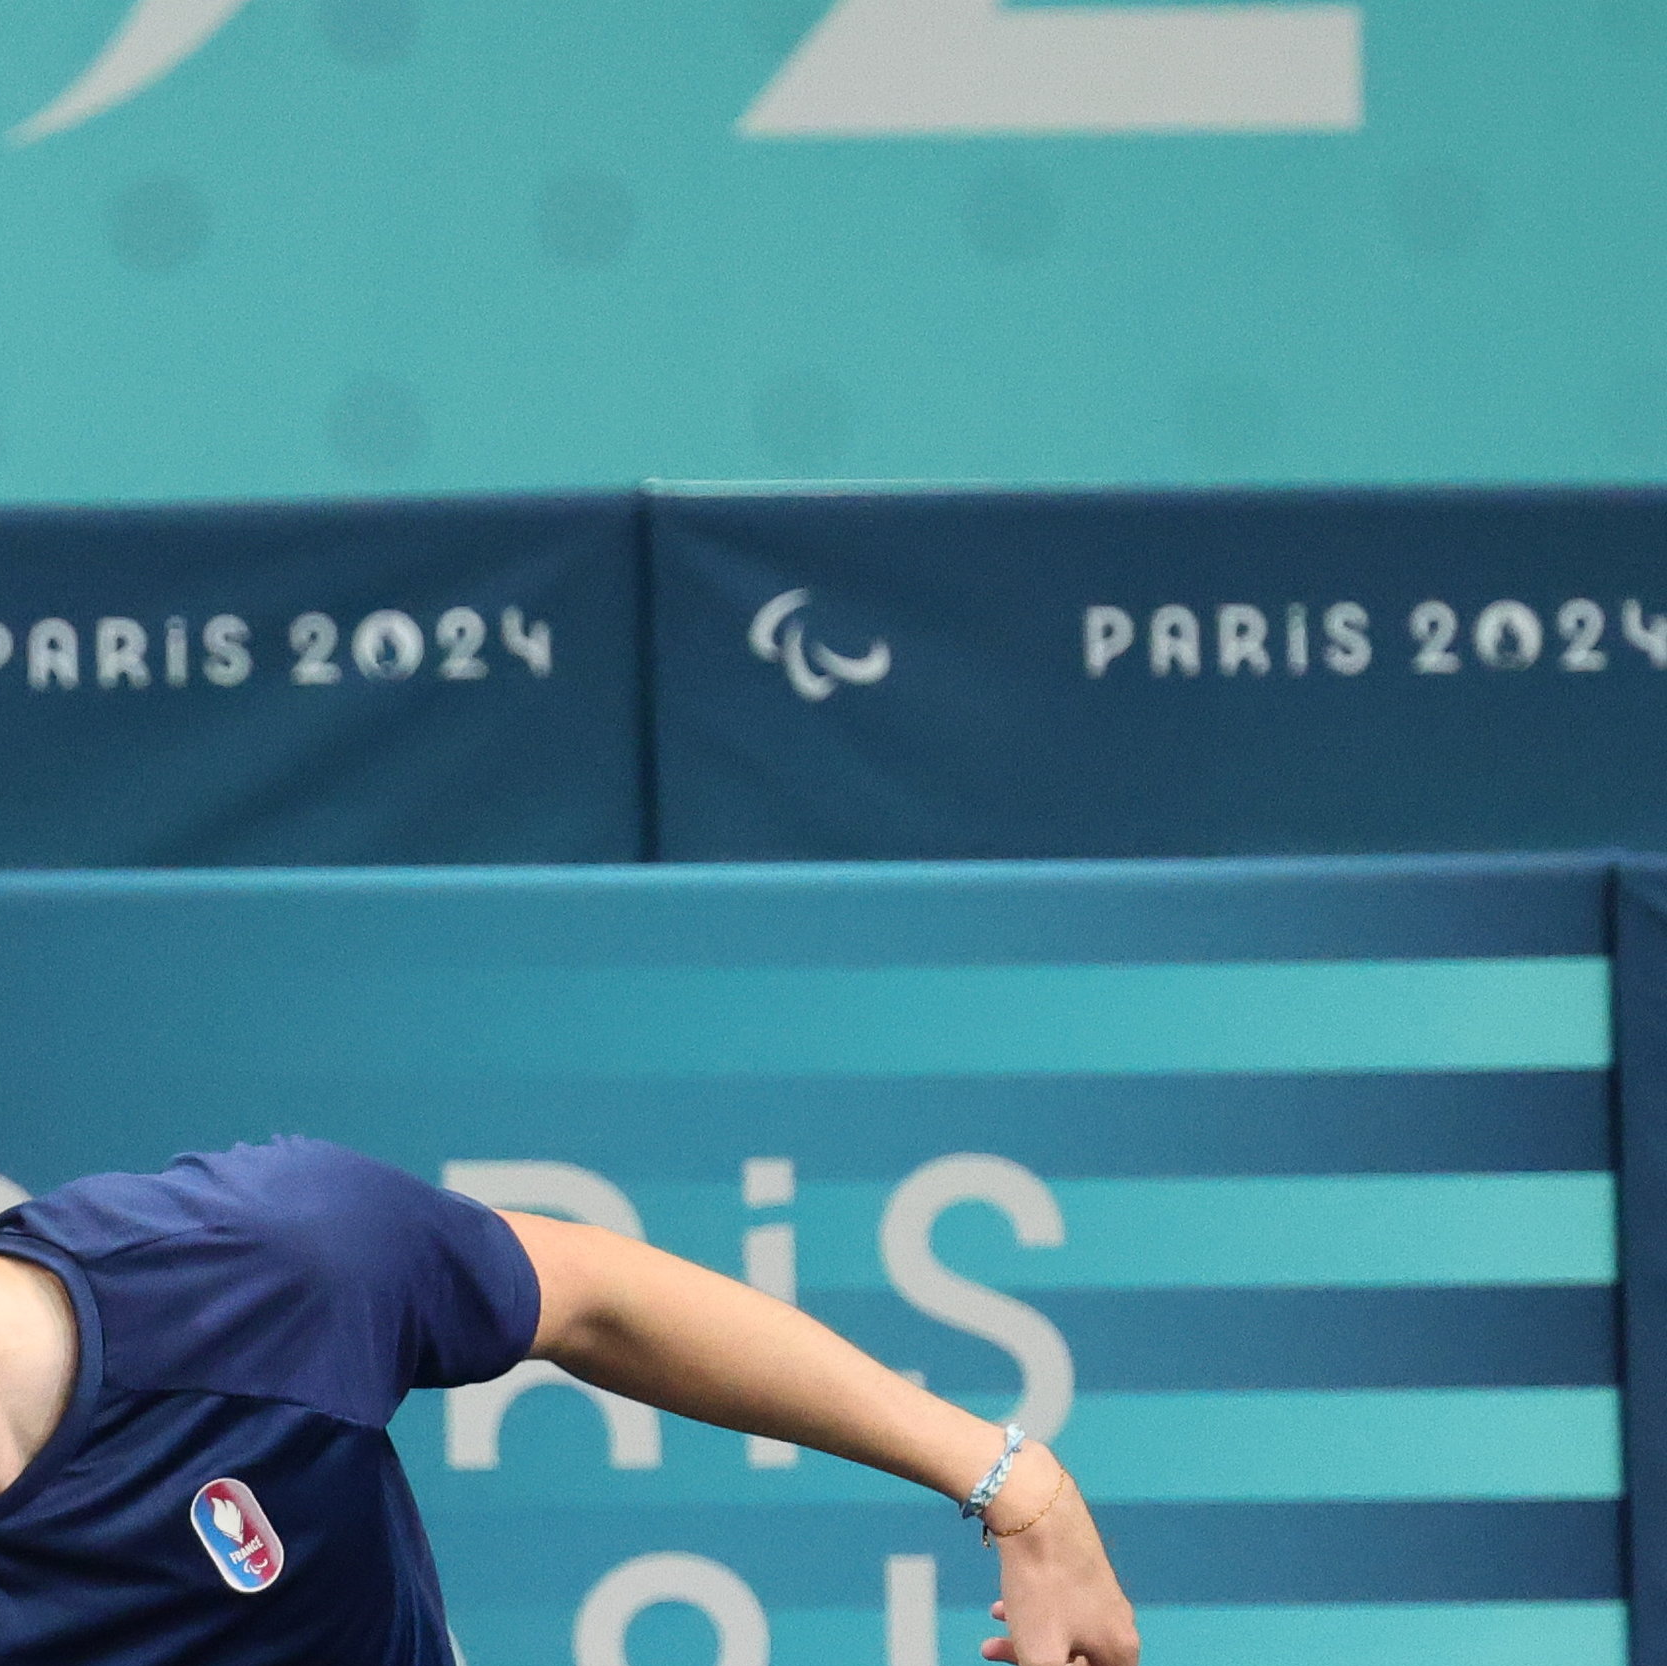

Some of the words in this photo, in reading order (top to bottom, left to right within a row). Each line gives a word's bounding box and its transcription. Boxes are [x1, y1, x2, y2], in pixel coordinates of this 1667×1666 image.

[289, 606, 553, 686] 2024
[1409, 597, 1667, 675] 2024
[229, 1534, 264, 1565] FRANCE
